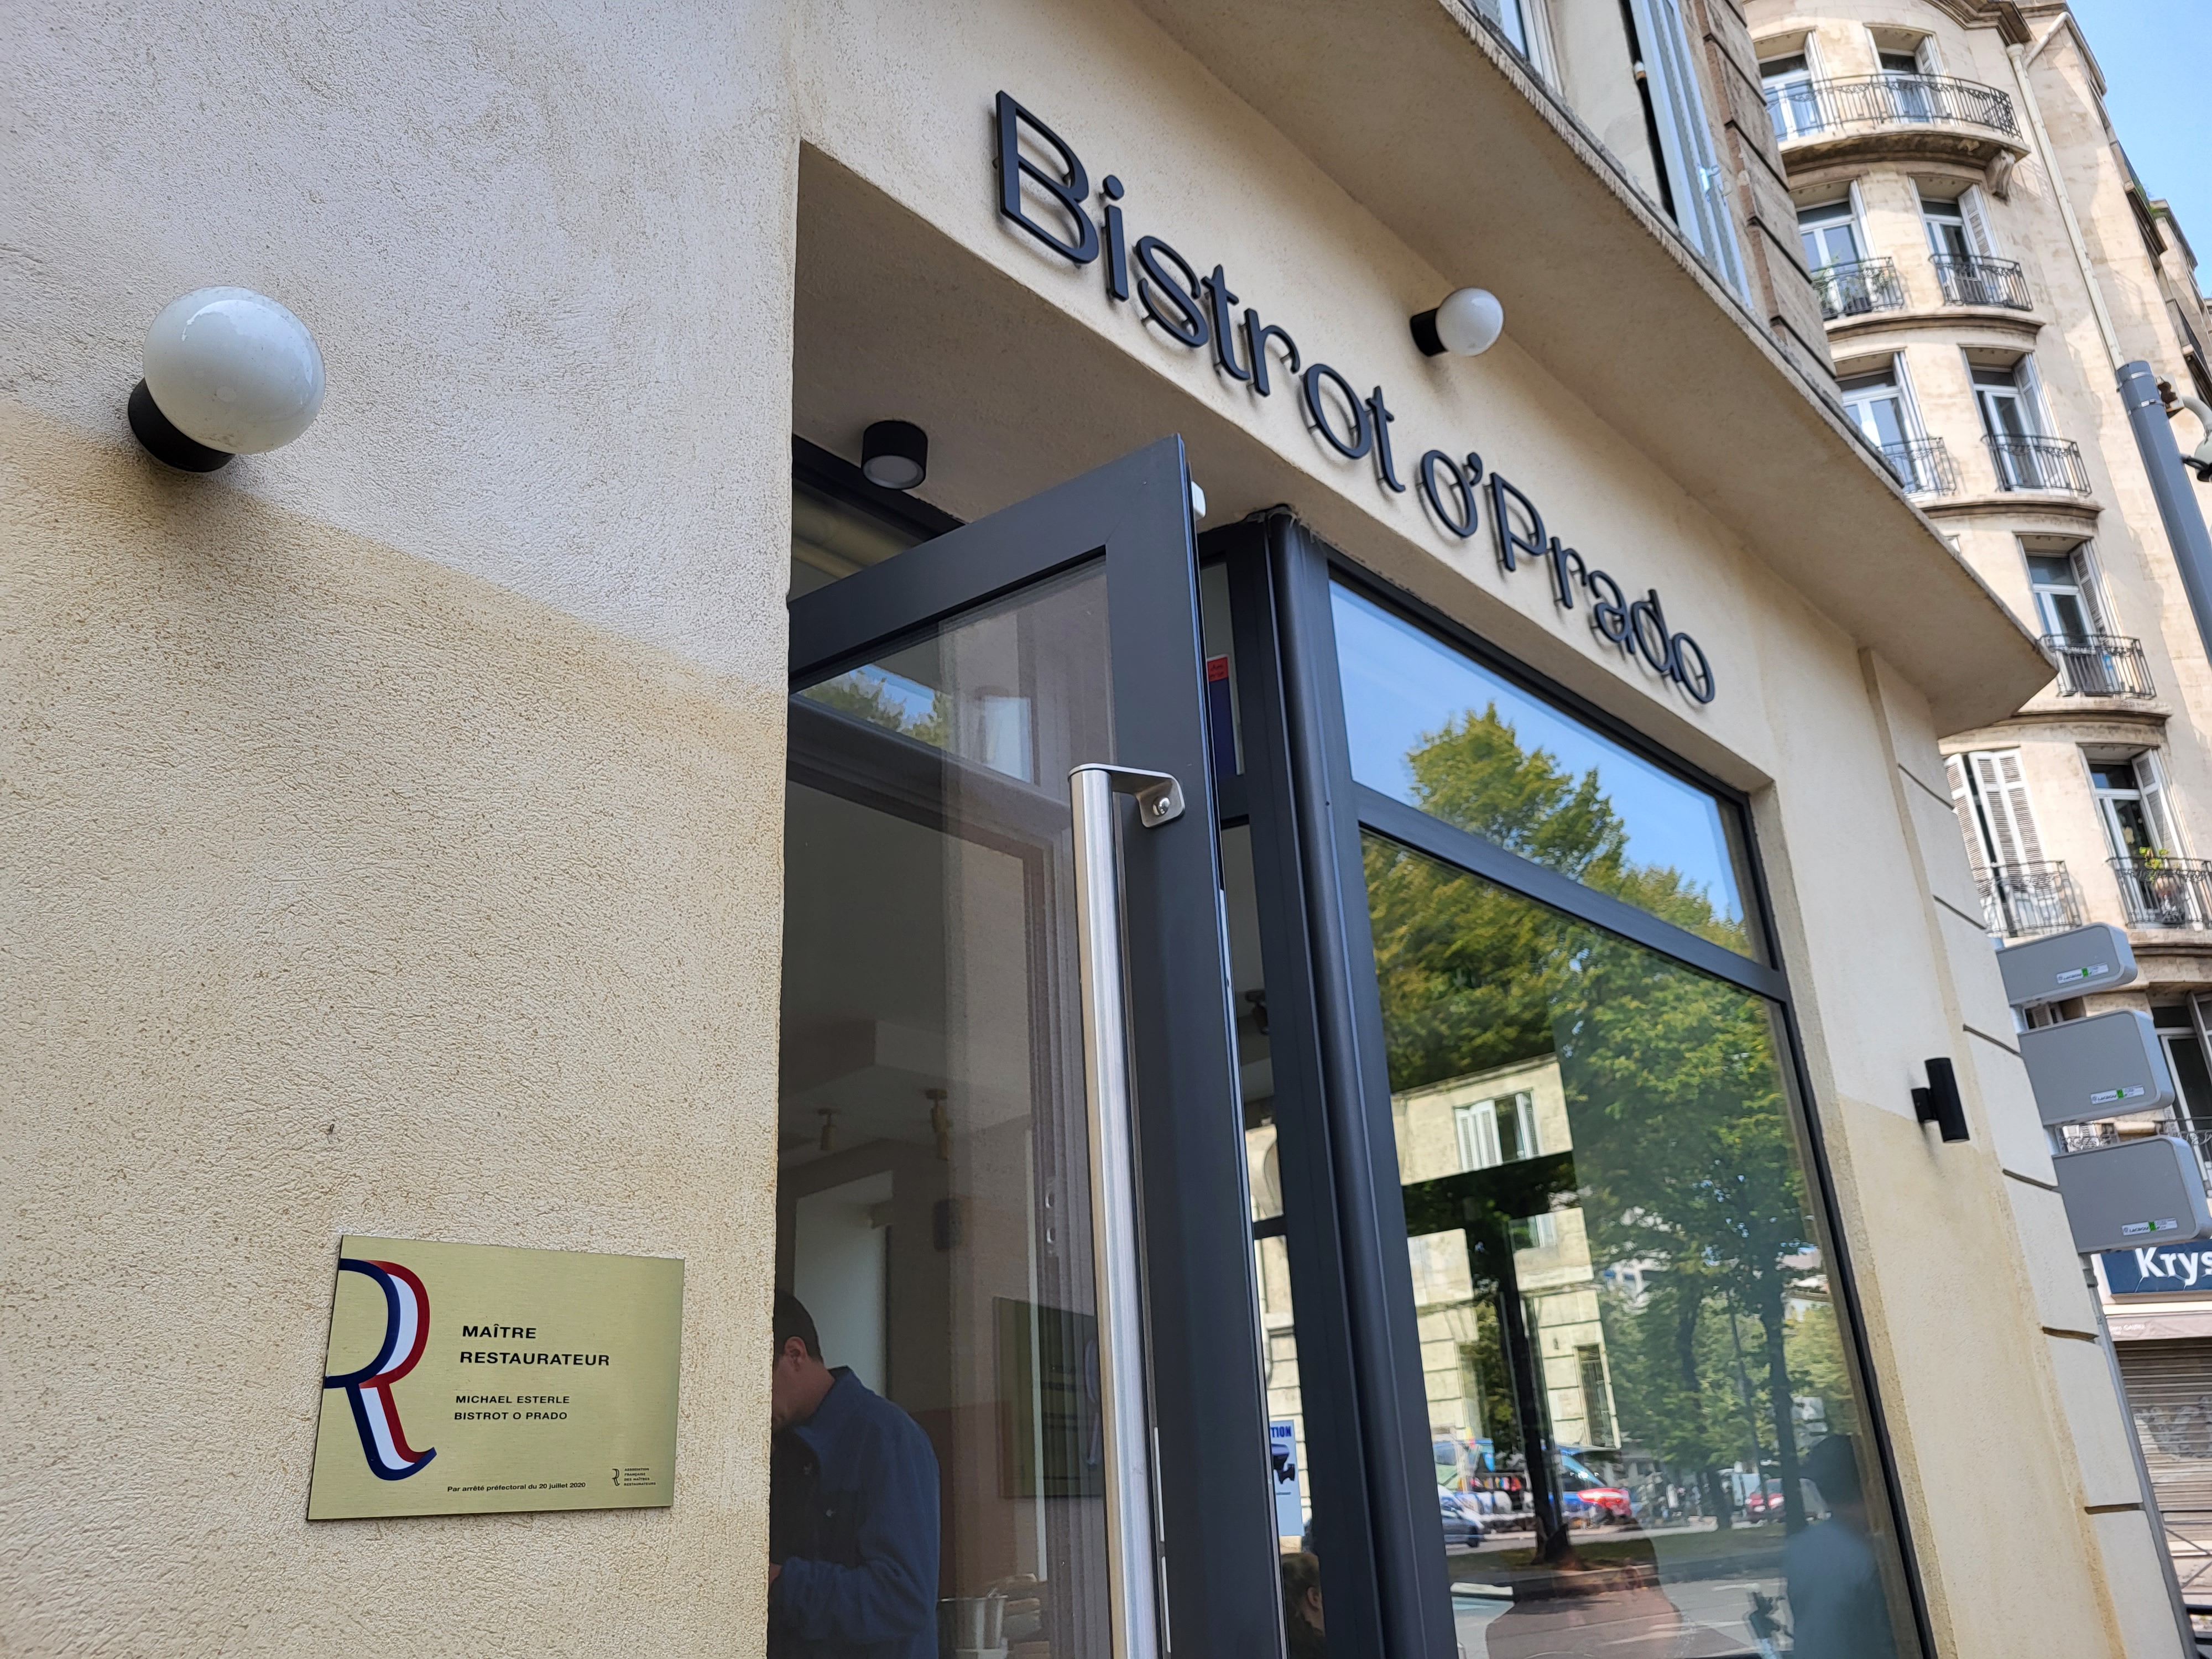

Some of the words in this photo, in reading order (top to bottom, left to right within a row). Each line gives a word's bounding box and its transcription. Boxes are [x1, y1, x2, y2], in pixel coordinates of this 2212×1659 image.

[996, 90, 1406, 493] Bistrot
[462, 1323, 536, 1339] MAÎTRE
[460, 1352, 609, 1366] RESTAURATEUR
[456, 1395, 512, 1404] MICHAEL
[454, 1412, 509, 1420] BISTROT
[487, 1484, 526, 1492] préfectoral
